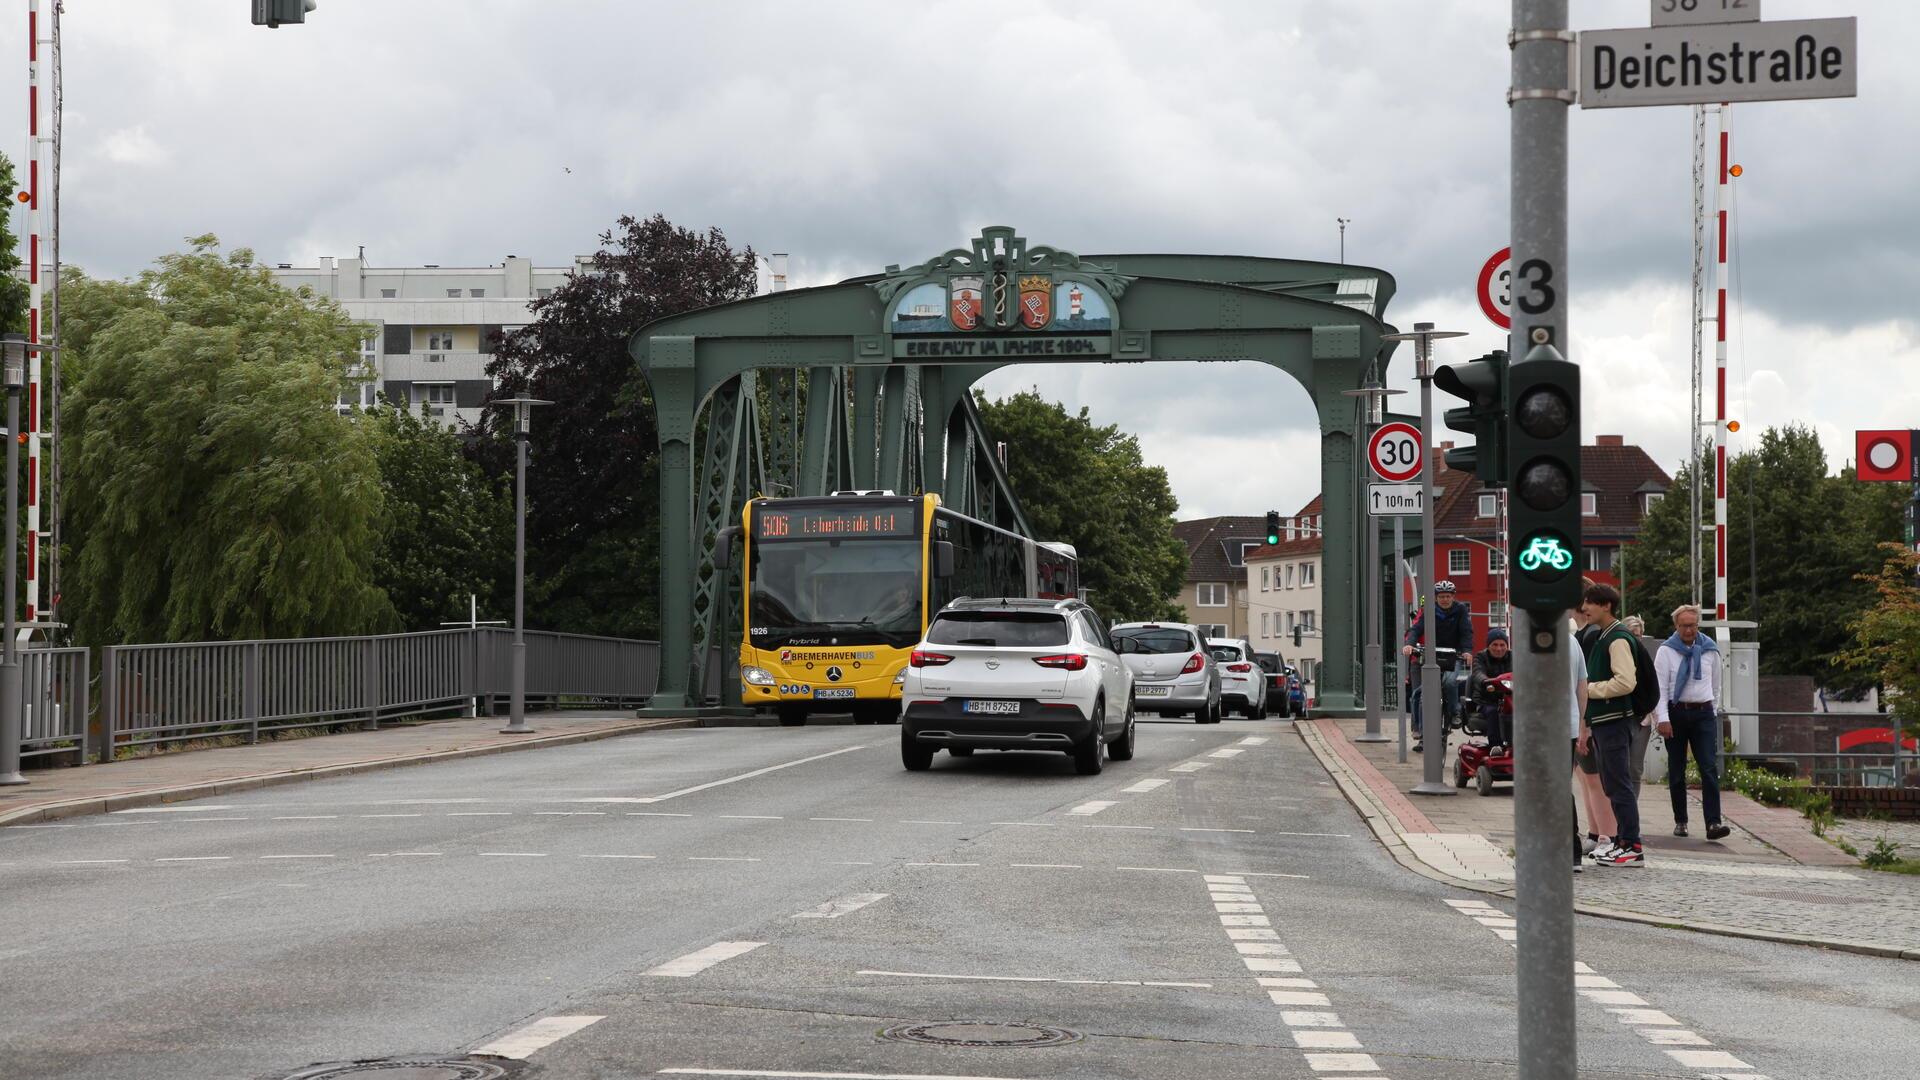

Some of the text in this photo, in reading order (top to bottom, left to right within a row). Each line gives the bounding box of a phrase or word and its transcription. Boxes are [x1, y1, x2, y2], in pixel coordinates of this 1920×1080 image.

[1594, 34, 1843, 90] Deichstraße
[1517, 258, 1556, 315] 3
[1381, 440, 1415, 466] 30
[750, 627, 768, 635] 1926
[968, 701, 1019, 712] HB M 8752E
